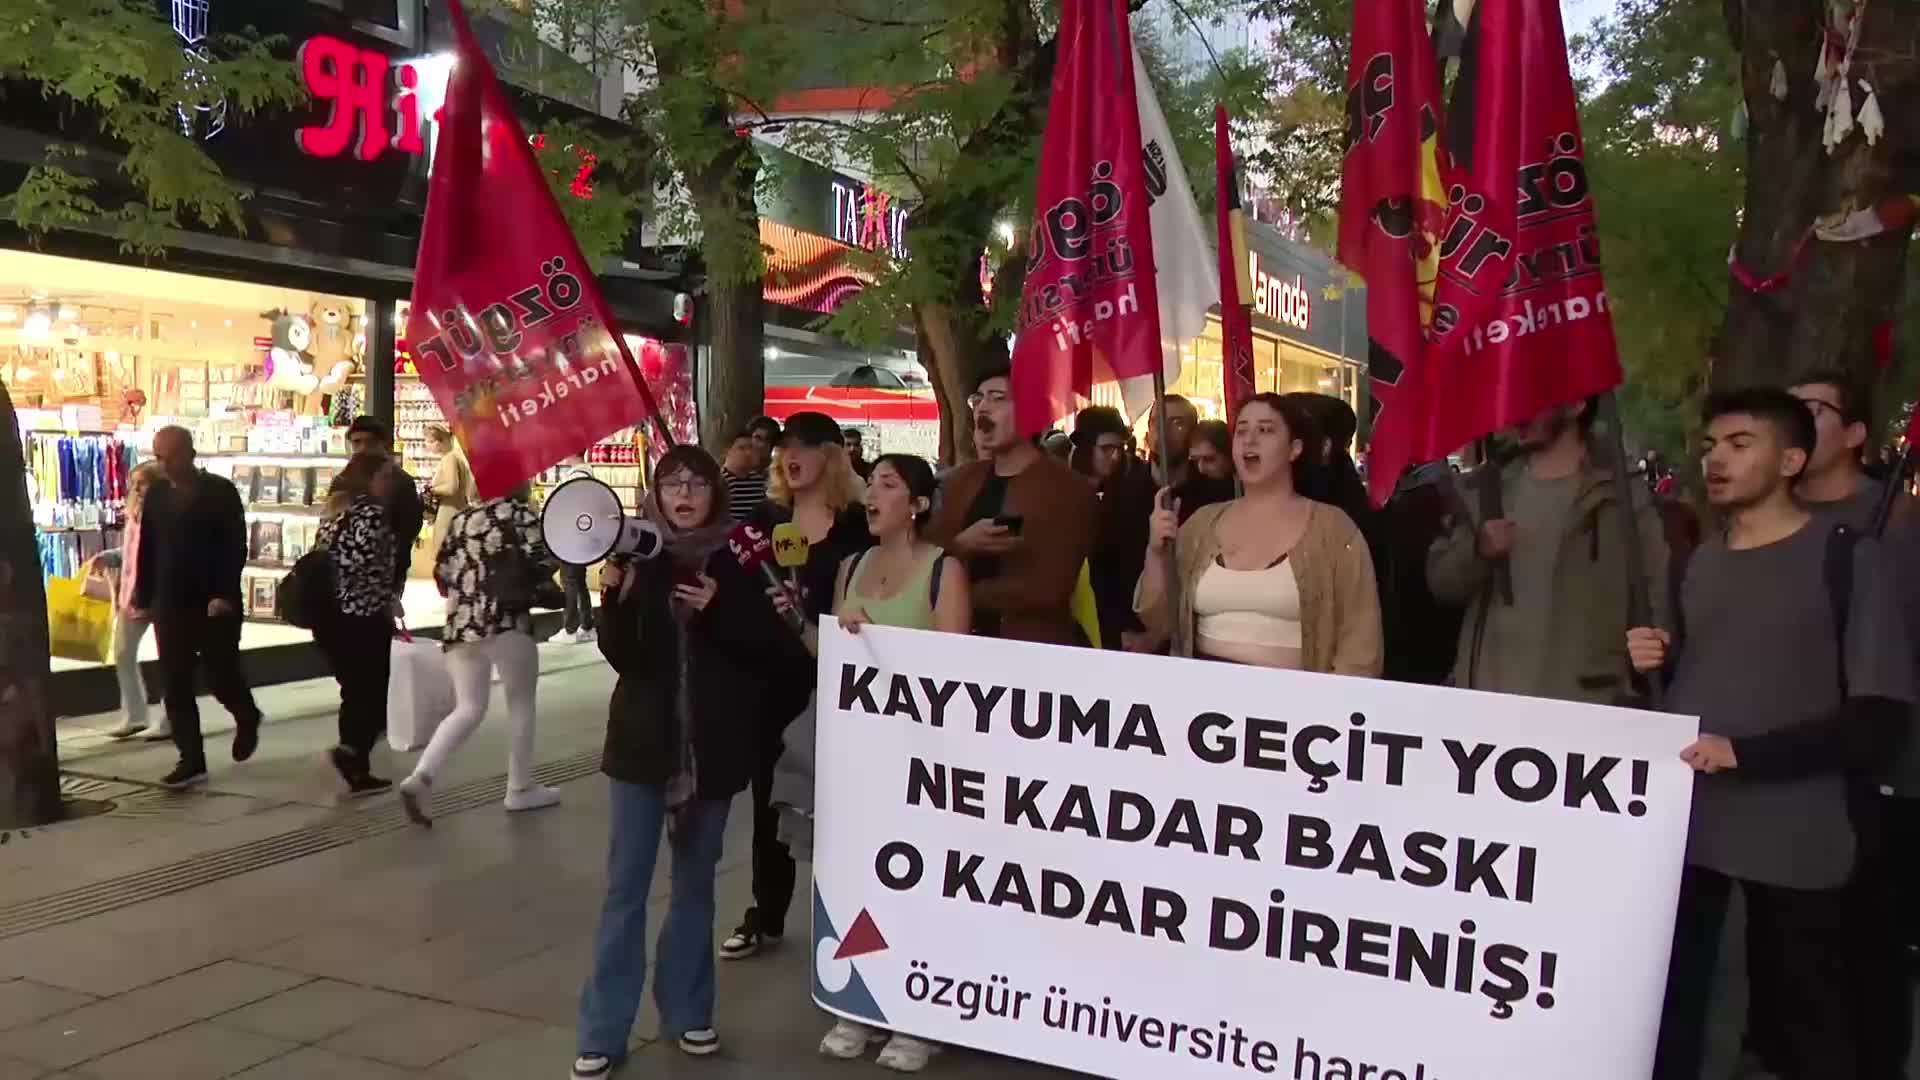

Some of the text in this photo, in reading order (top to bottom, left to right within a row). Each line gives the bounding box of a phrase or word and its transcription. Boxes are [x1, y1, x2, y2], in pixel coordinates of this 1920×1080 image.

[838, 663, 1650, 817] KAYYUMA GEÇİT YOK!
[906, 757, 1537, 903] NE KADAR BASKI
[874, 841, 1558, 1020] O KADAR DİRENİŞ!
[905, 960, 1031, 1021] özgür
[1042, 985, 1279, 1074] üniversite
